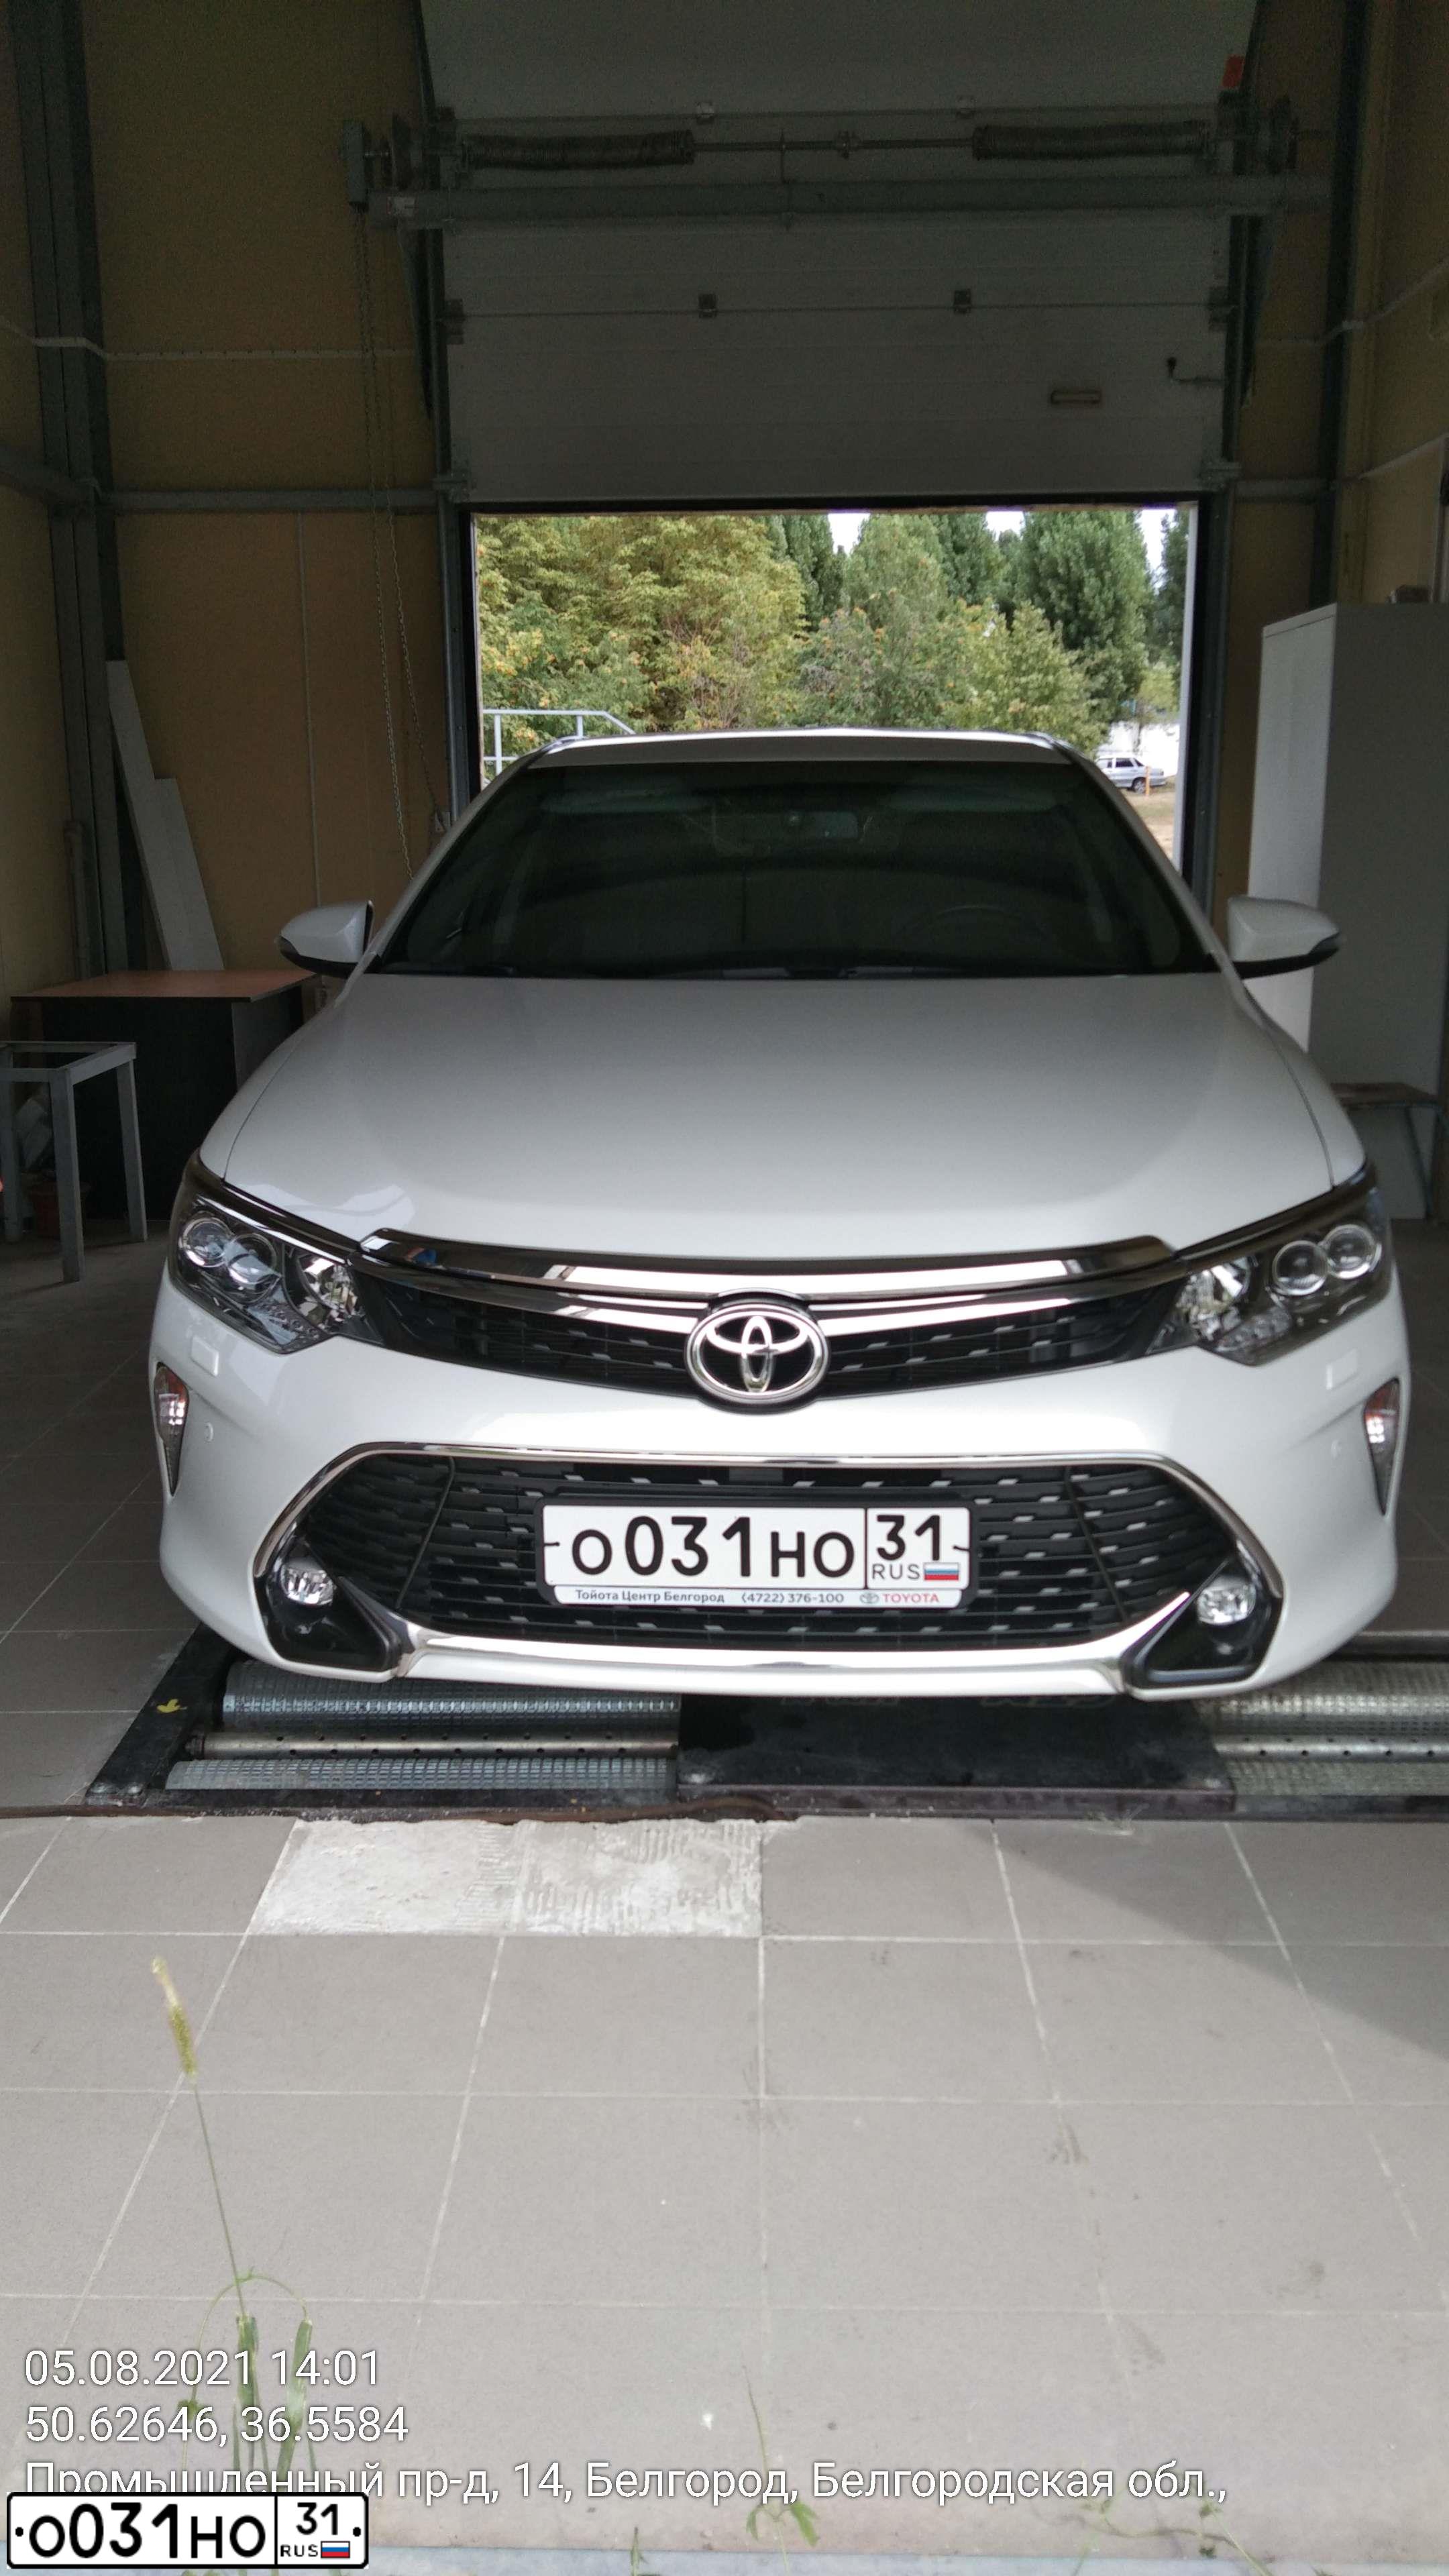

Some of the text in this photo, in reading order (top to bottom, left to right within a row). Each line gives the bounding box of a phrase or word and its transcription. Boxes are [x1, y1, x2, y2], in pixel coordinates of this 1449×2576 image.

[876, 1514, 941, 1562] 31
[871, 1563, 920, 1580] RUS
[575, 1589, 845, 1604] Тойота Центр Белгород (4722) 376-100
[882, 1593, 941, 1604] TOYOTA
